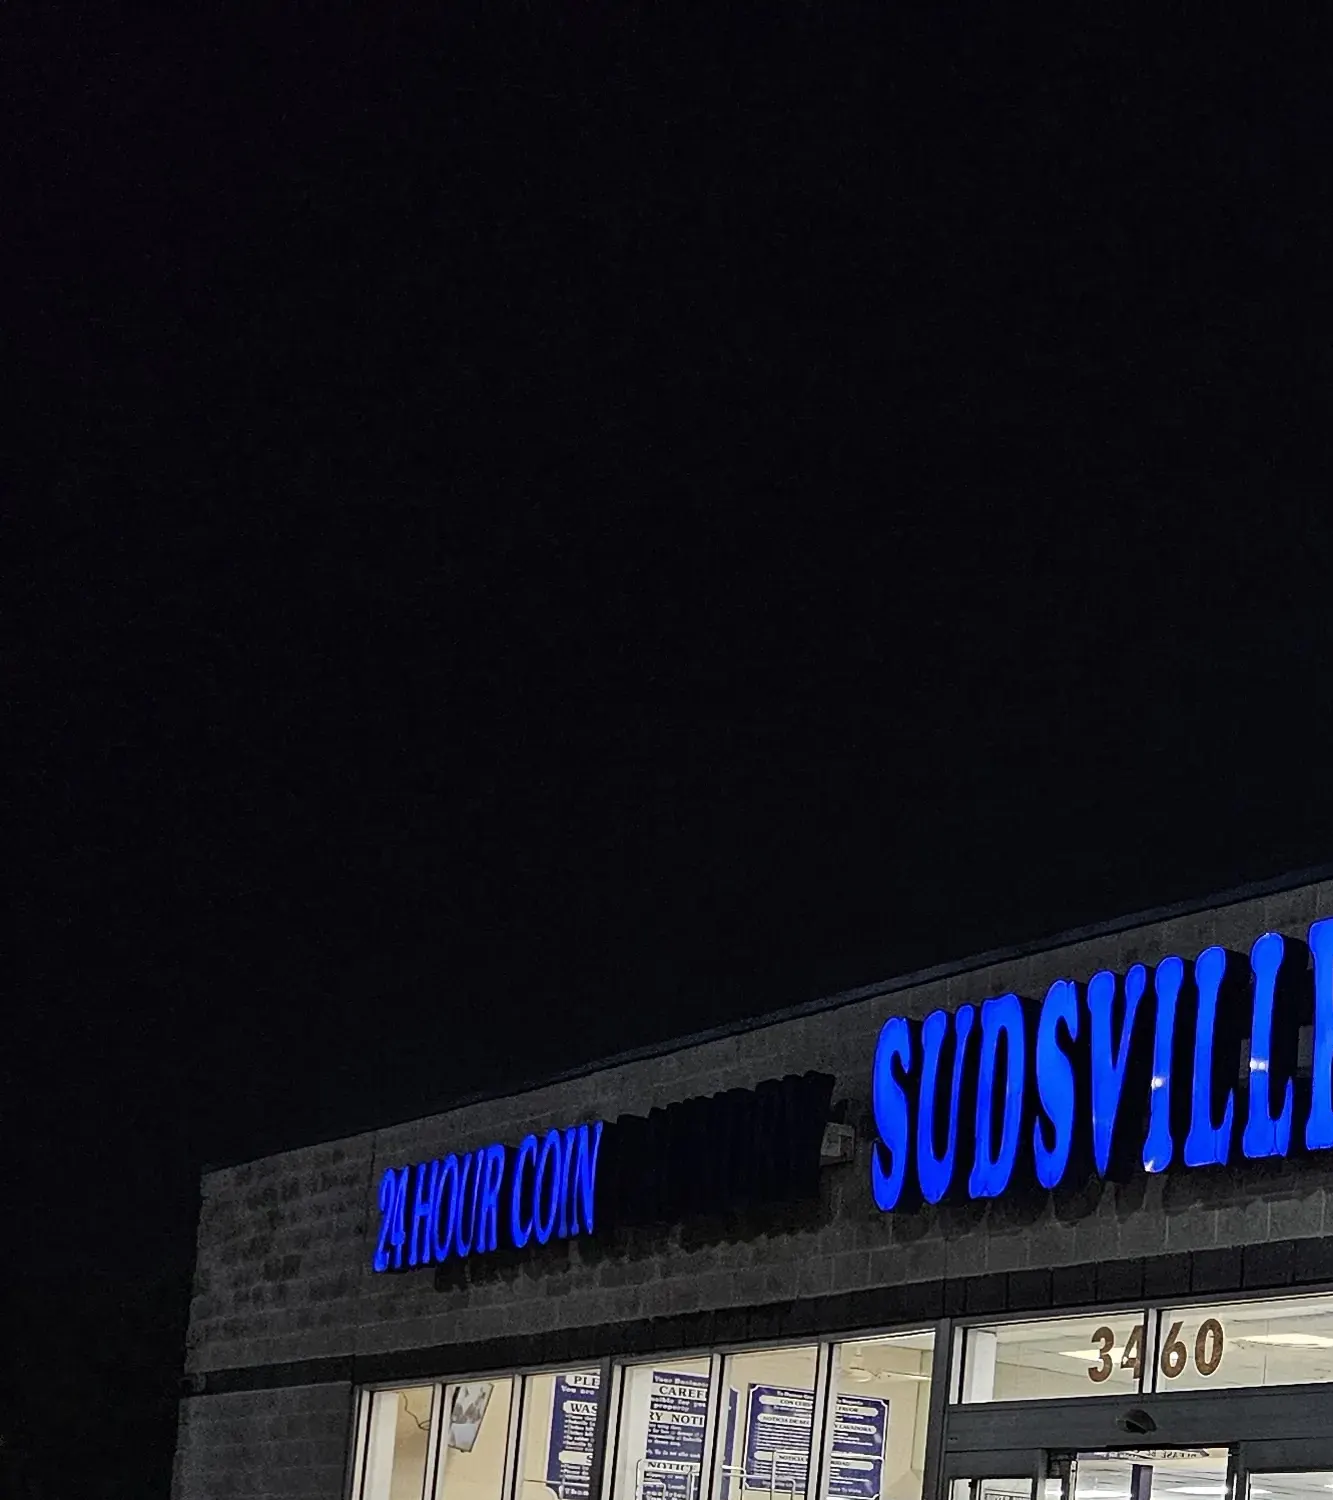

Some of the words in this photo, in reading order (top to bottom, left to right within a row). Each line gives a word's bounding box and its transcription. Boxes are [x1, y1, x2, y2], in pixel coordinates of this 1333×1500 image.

[372, 1165, 411, 1274] 24
[407, 1142, 506, 1267] HOUR
[510, 1120, 604, 1249] COIN
[1087, 1317, 1224, 1384] 3460
